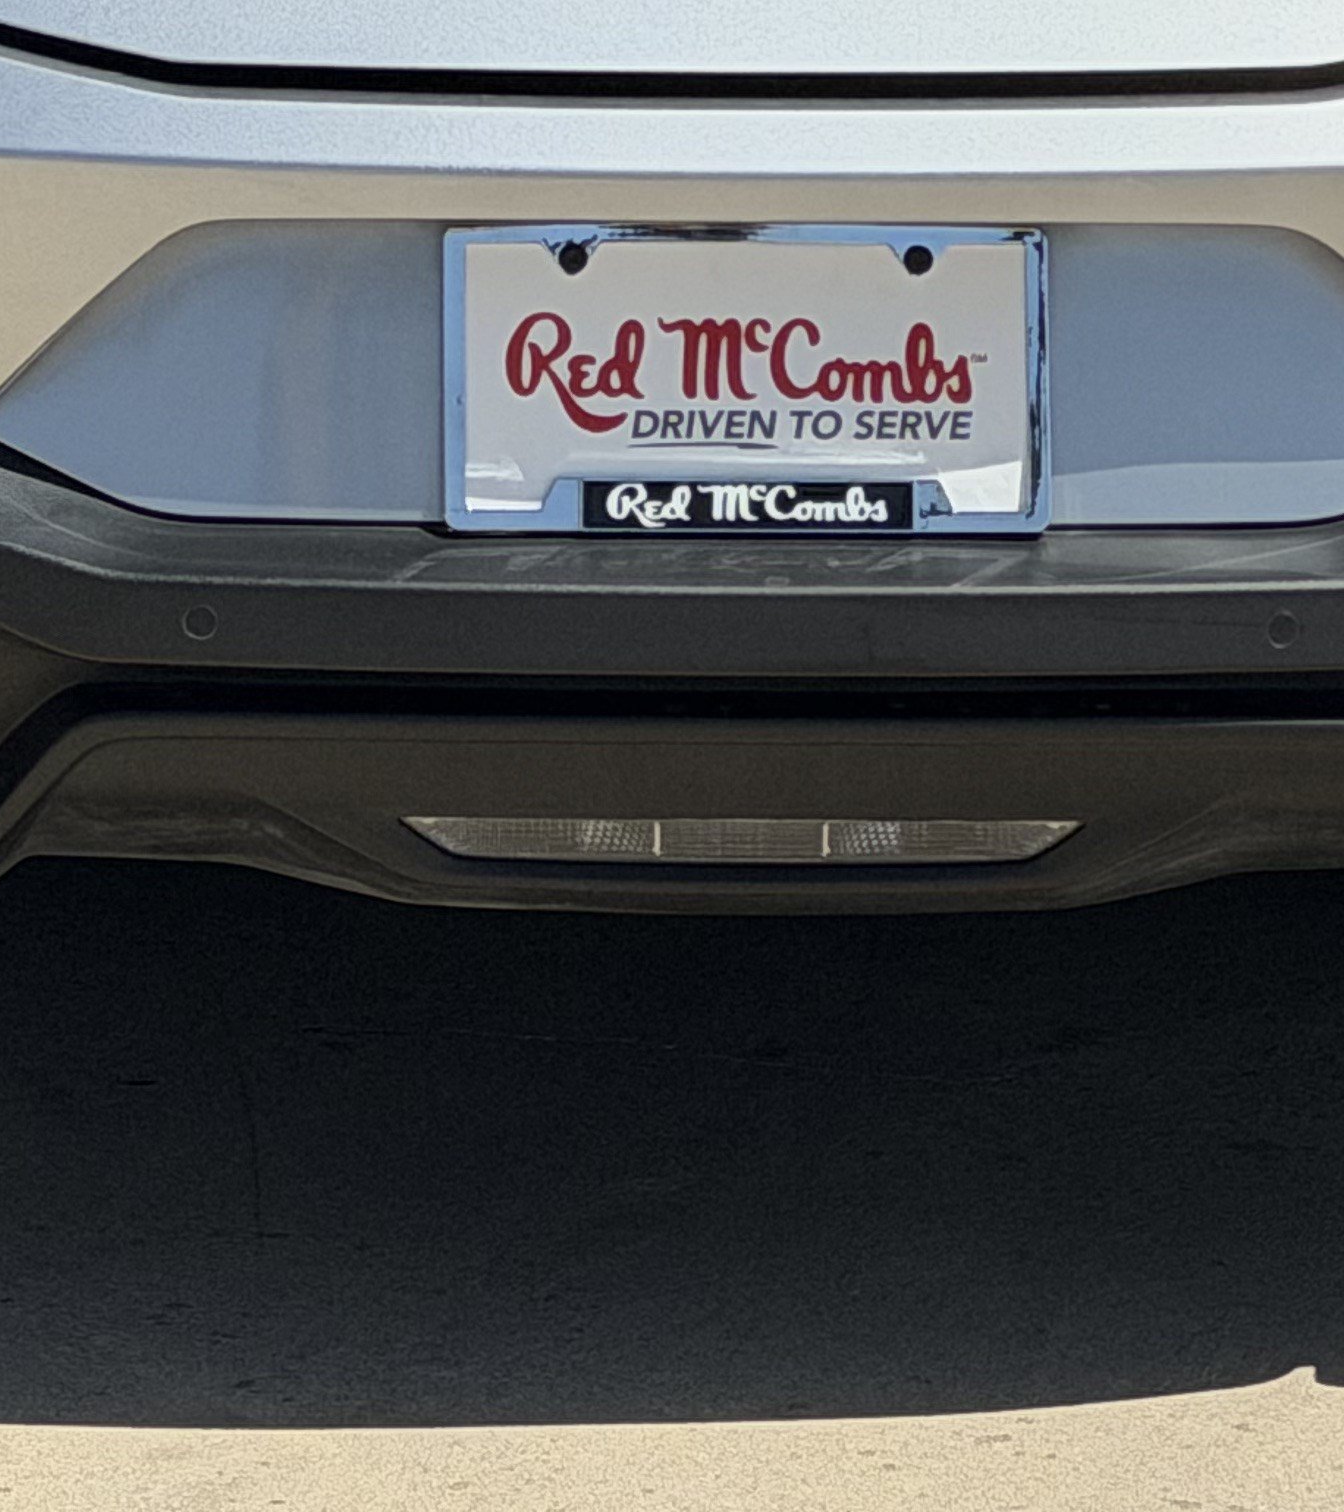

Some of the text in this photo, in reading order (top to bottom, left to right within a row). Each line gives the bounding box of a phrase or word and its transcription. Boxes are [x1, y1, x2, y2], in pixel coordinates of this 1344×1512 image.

[505, 312, 973, 433] Red McCombs
[630, 410, 974, 440] DRIVEN TO SERVE
[605, 483, 889, 527] Red McCombs
